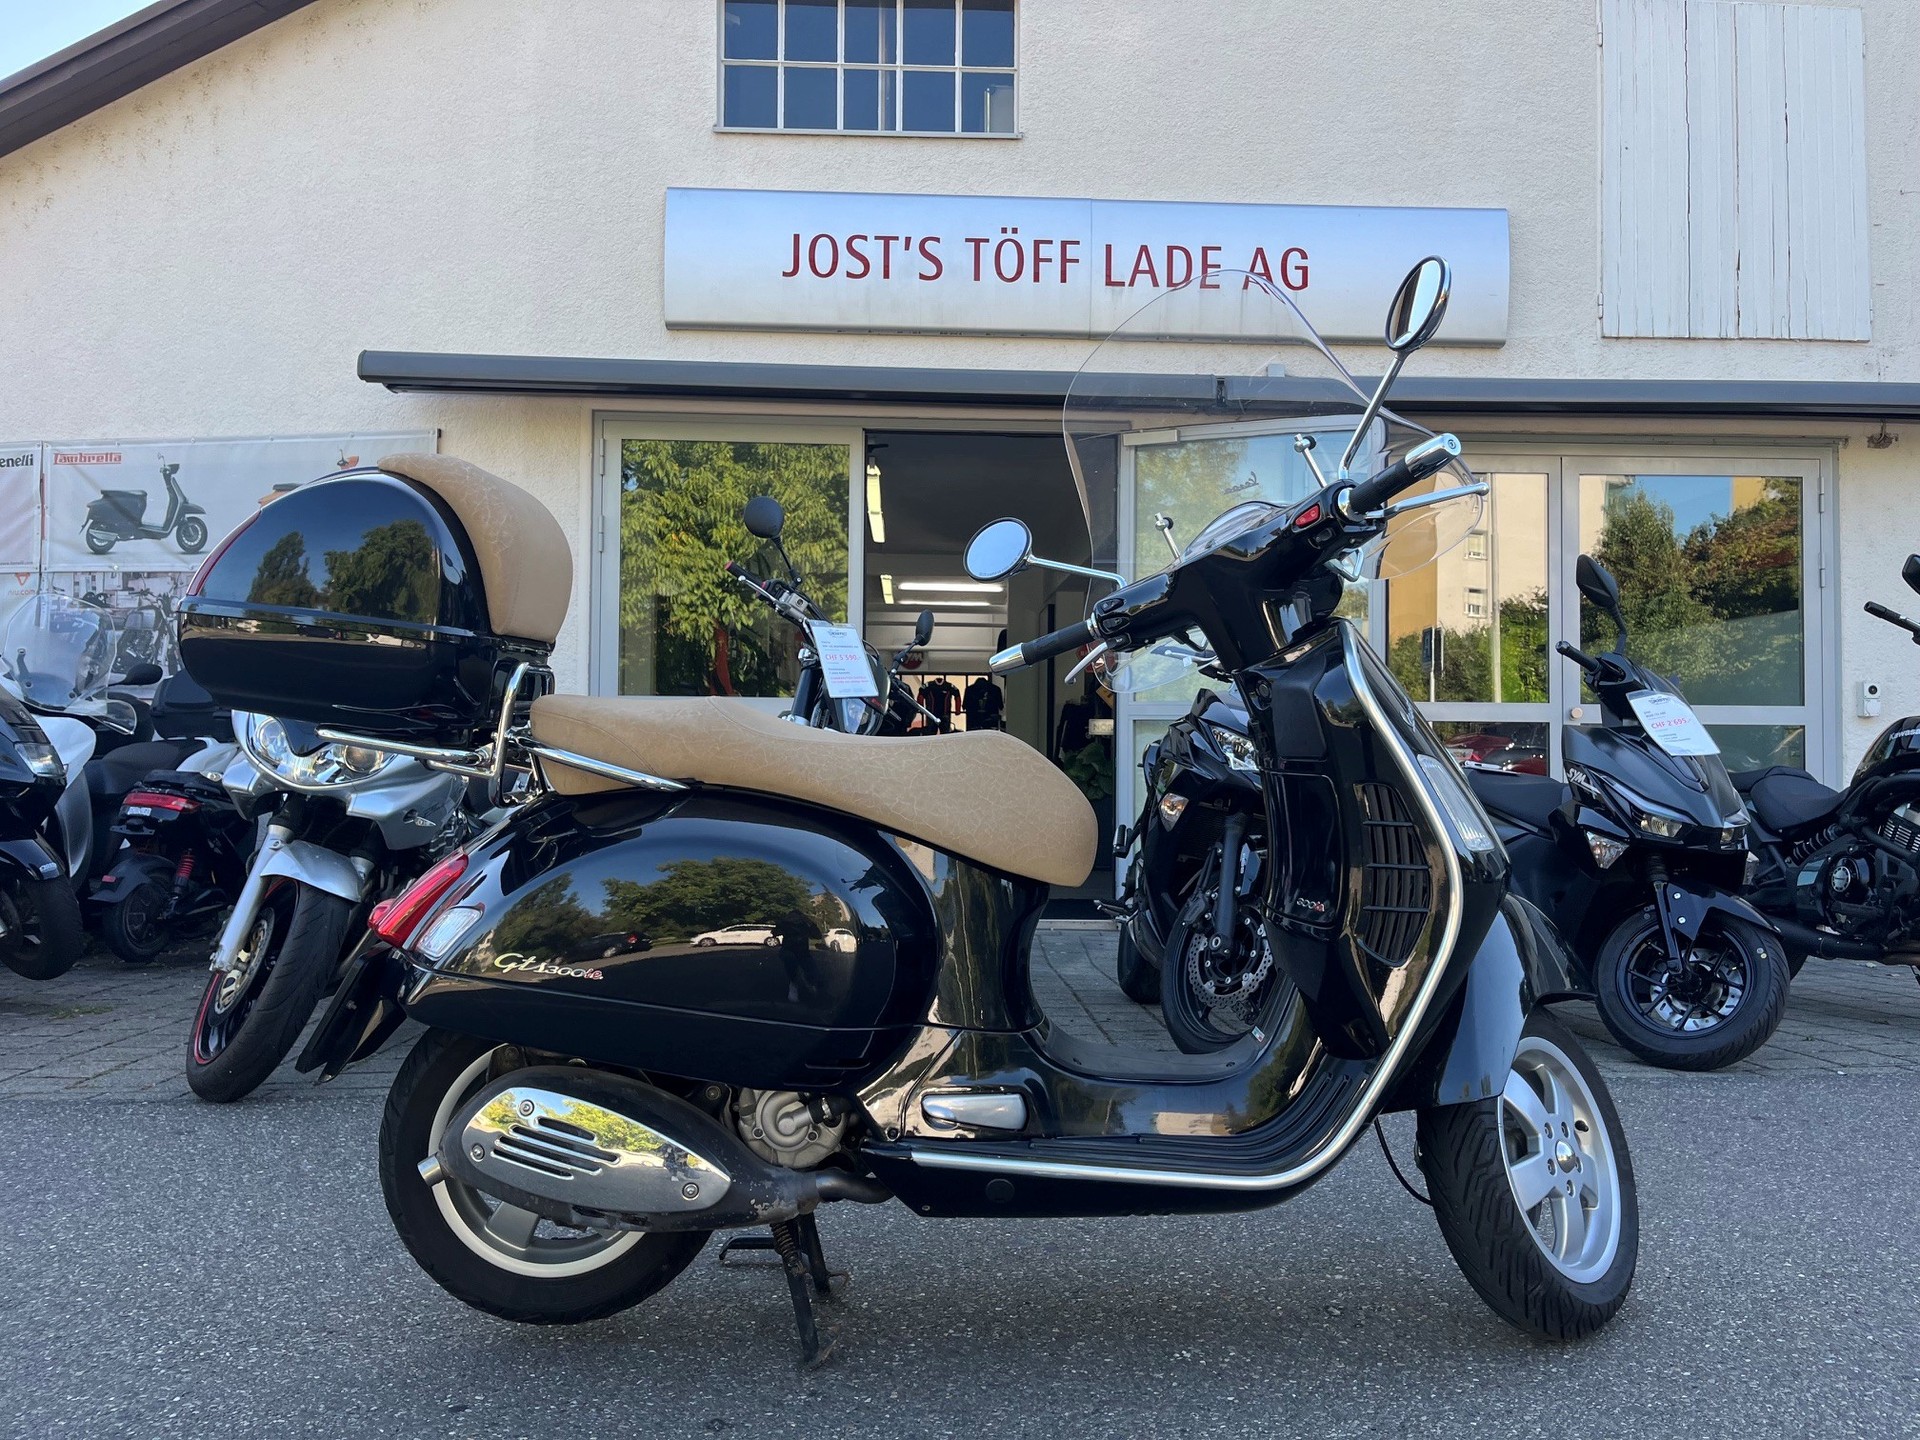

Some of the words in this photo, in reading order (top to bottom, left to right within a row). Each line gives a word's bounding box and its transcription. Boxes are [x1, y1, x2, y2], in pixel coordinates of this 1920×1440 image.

[782, 233, 942, 281] JOST'S
[965, 228, 1081, 284] TÖFF
[1105, 243, 1222, 289] LADE
[1242, 247, 1309, 291] AG
[1651, 720, 1666, 729] CHF
